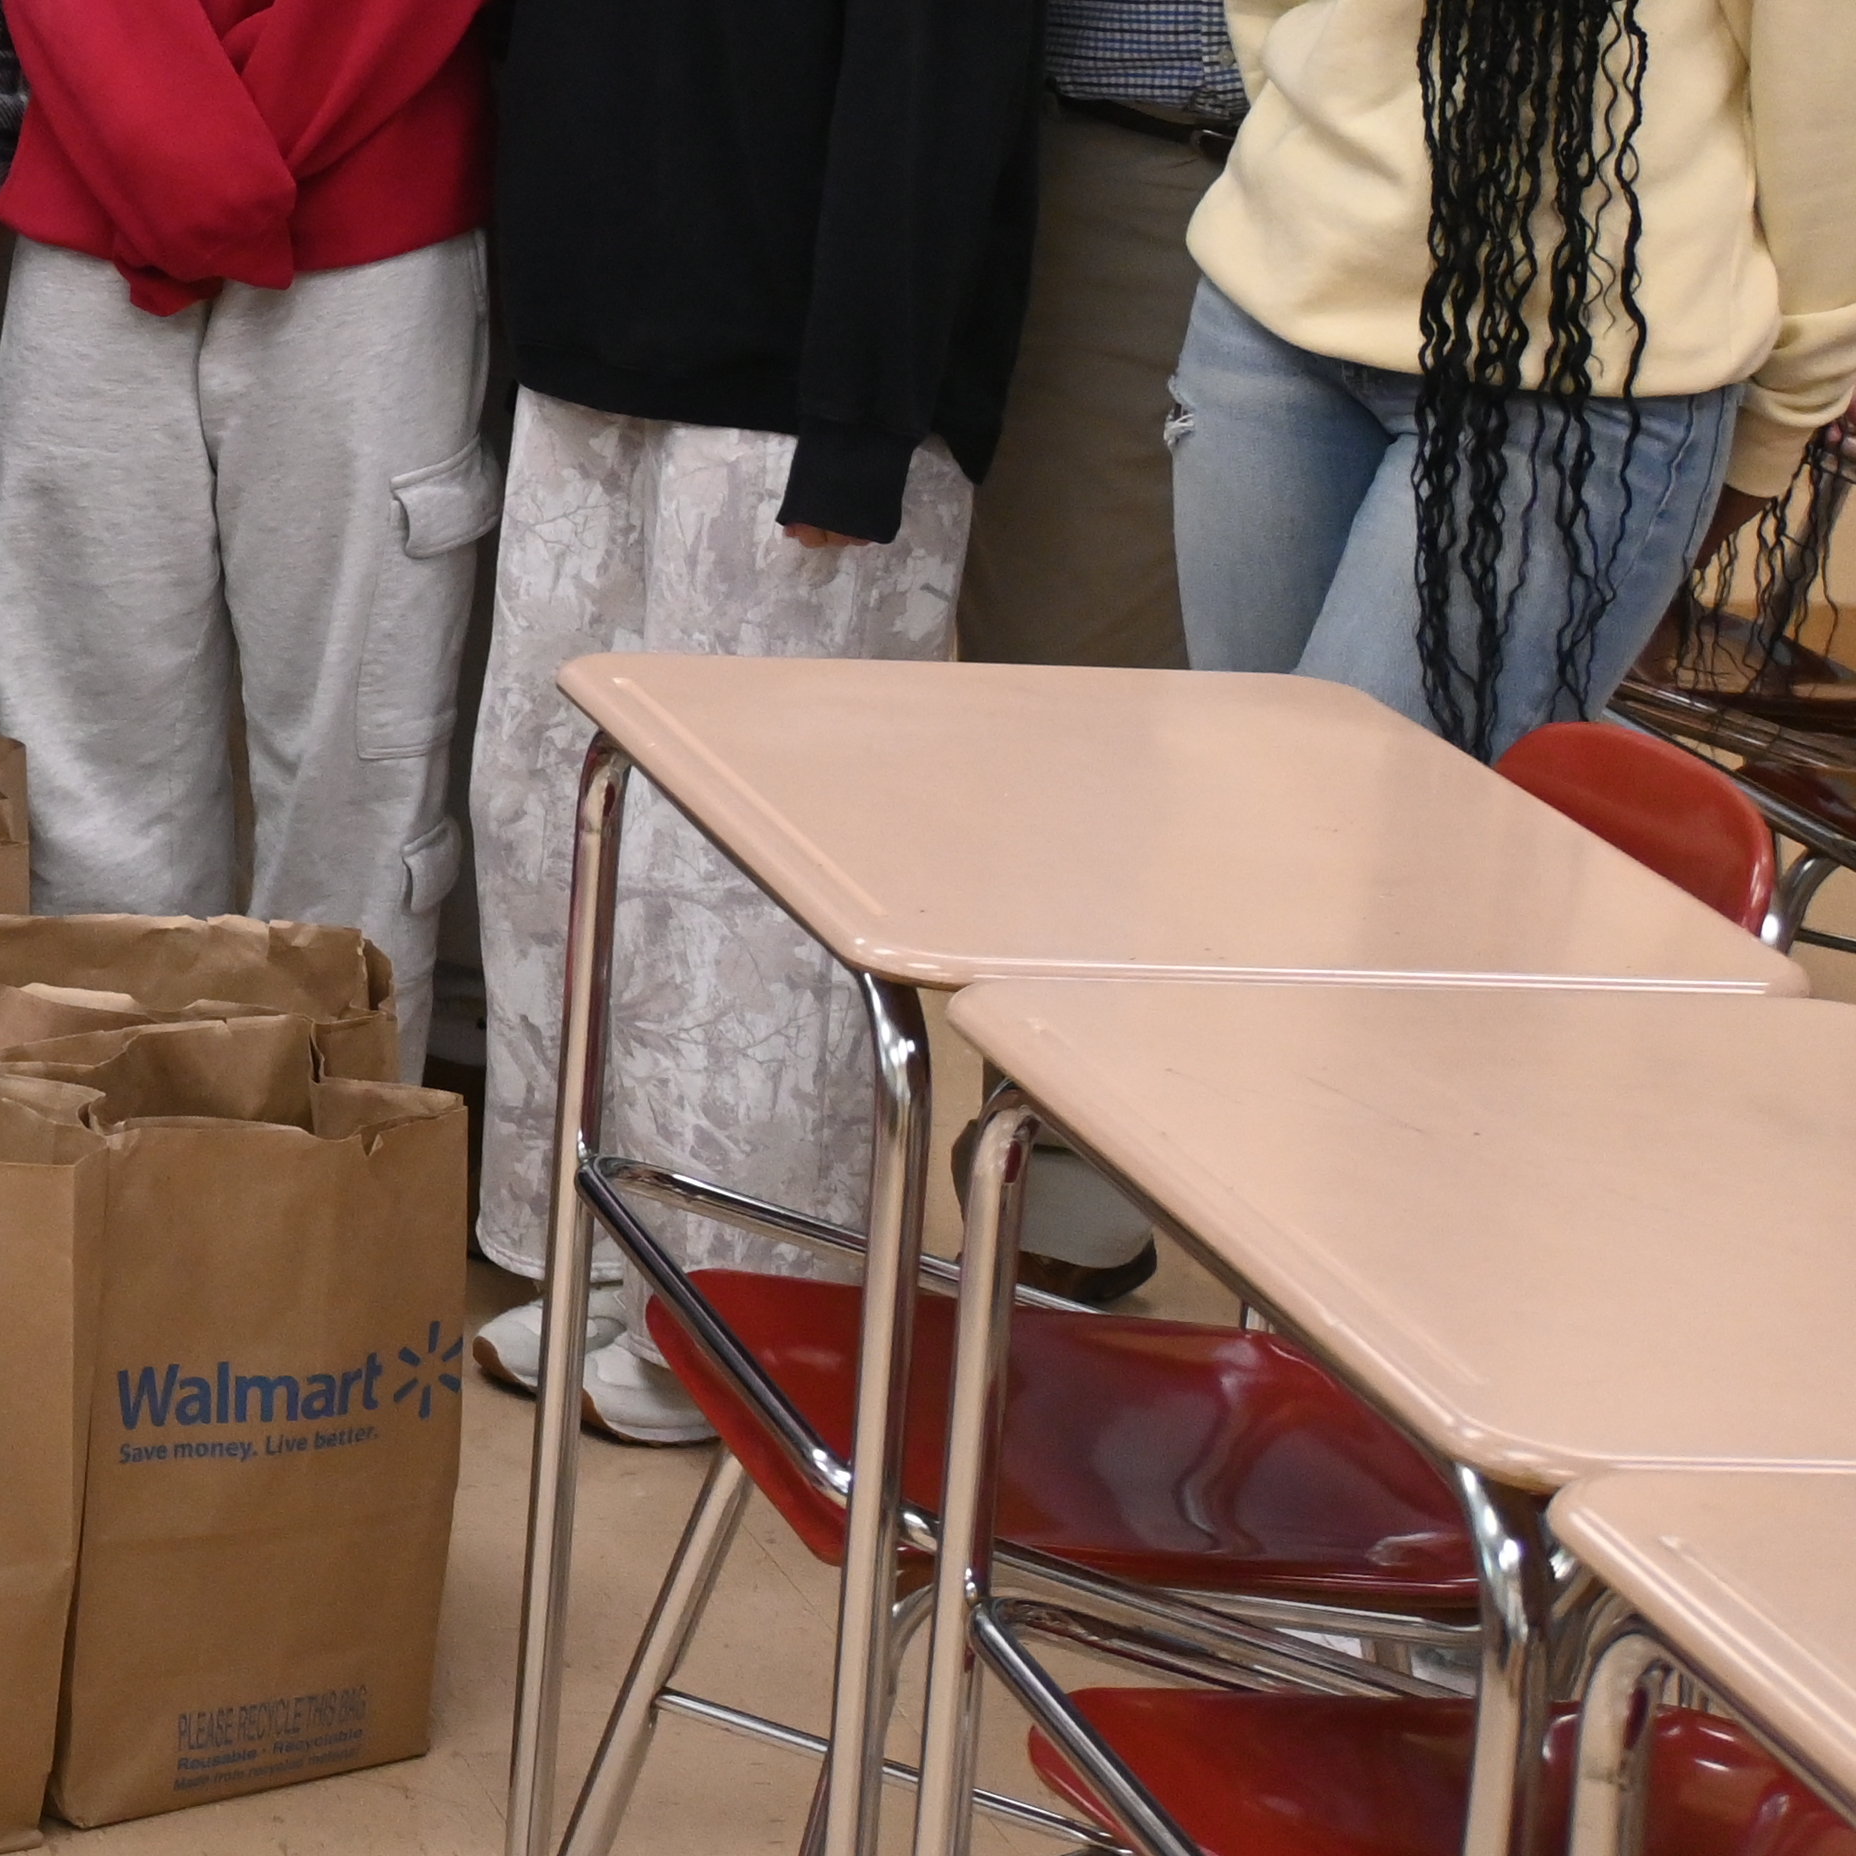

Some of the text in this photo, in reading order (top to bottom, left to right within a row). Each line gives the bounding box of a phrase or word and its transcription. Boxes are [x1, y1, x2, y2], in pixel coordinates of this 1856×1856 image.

[117, 1351, 383, 1431] Walmart
[118, 1424, 380, 1465] Save money. Live better.
[177, 1707, 234, 1753] PLEASE
[239, 1697, 302, 1743] RECYCLE
[177, 1727, 364, 1771] Reusable Recyclable
